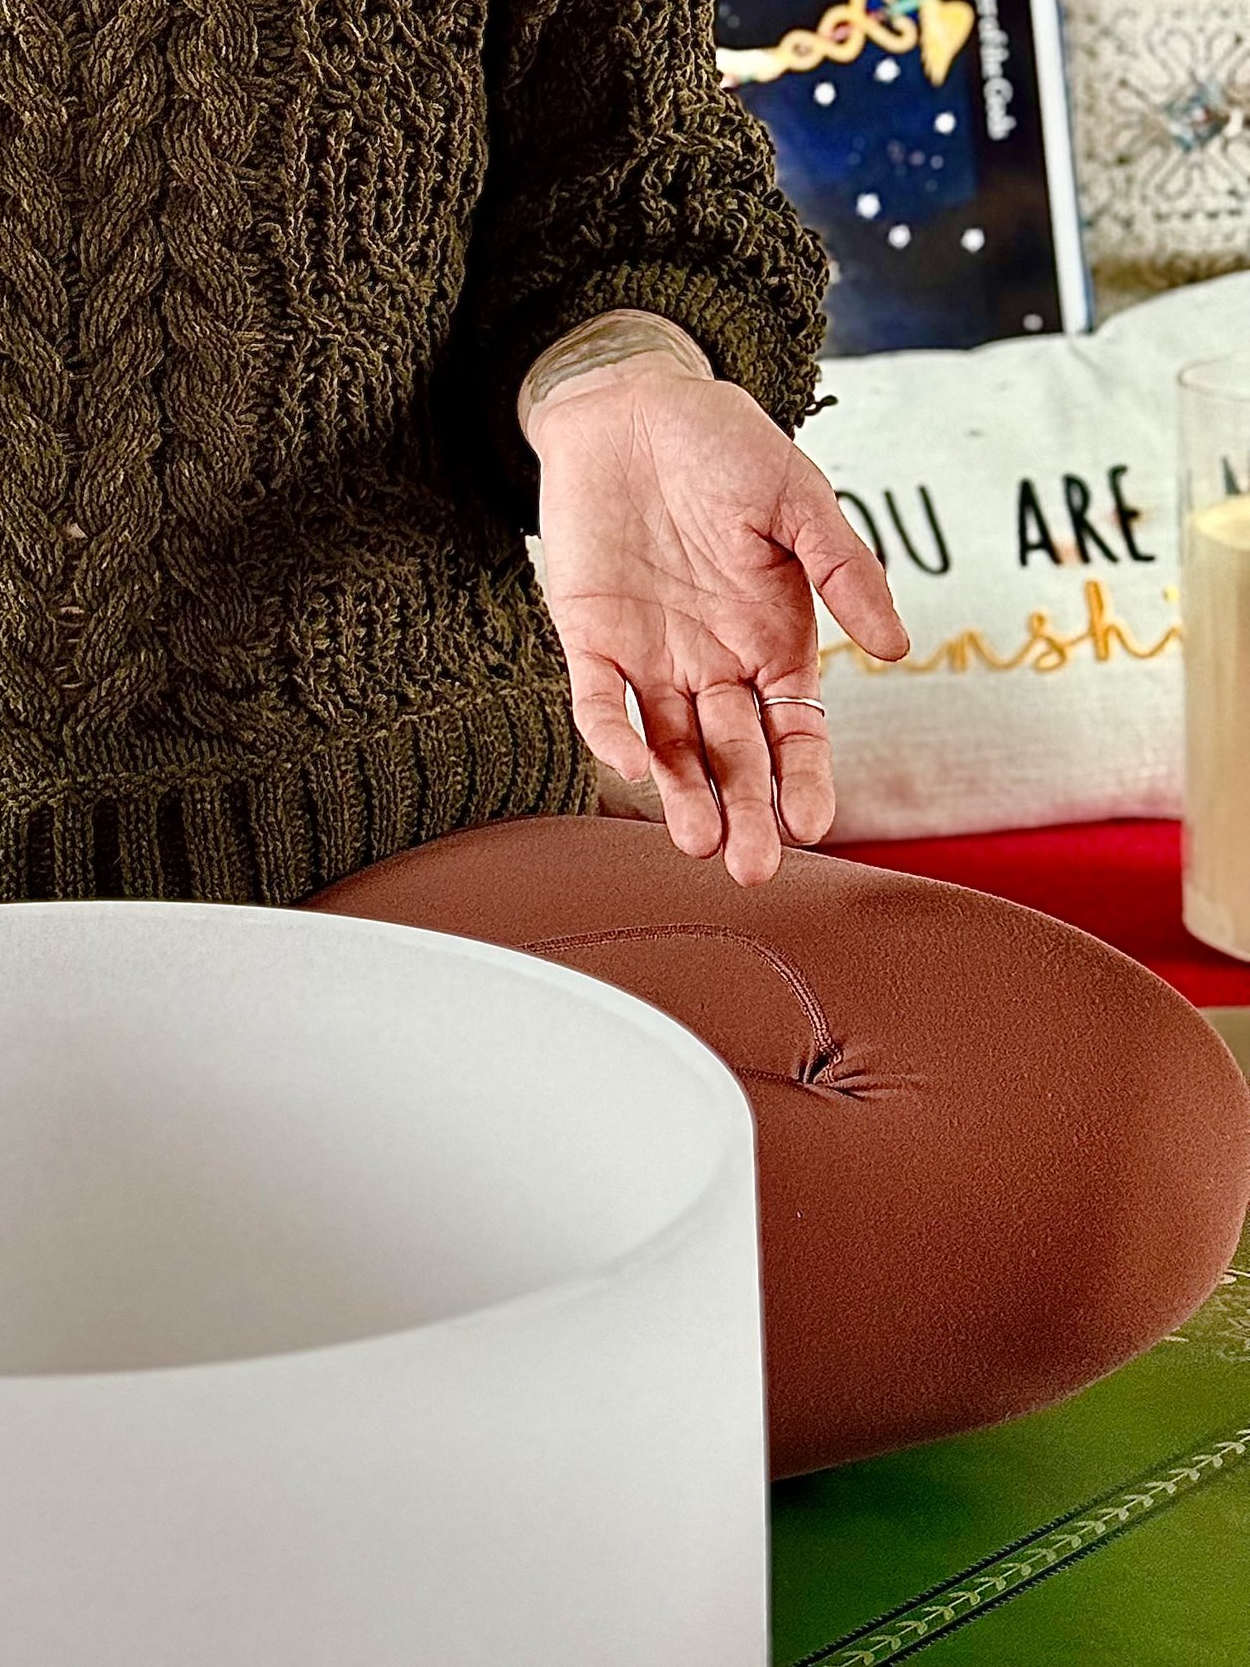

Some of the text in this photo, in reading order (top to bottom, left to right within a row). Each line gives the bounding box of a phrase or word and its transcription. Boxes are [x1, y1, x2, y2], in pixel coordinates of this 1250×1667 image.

[978, 17, 1009, 47] of
[981, 46, 1010, 78] the
[983, 78, 1016, 140] Gods
[836, 485, 951, 576] OU
[1017, 465, 1156, 568] ARE
